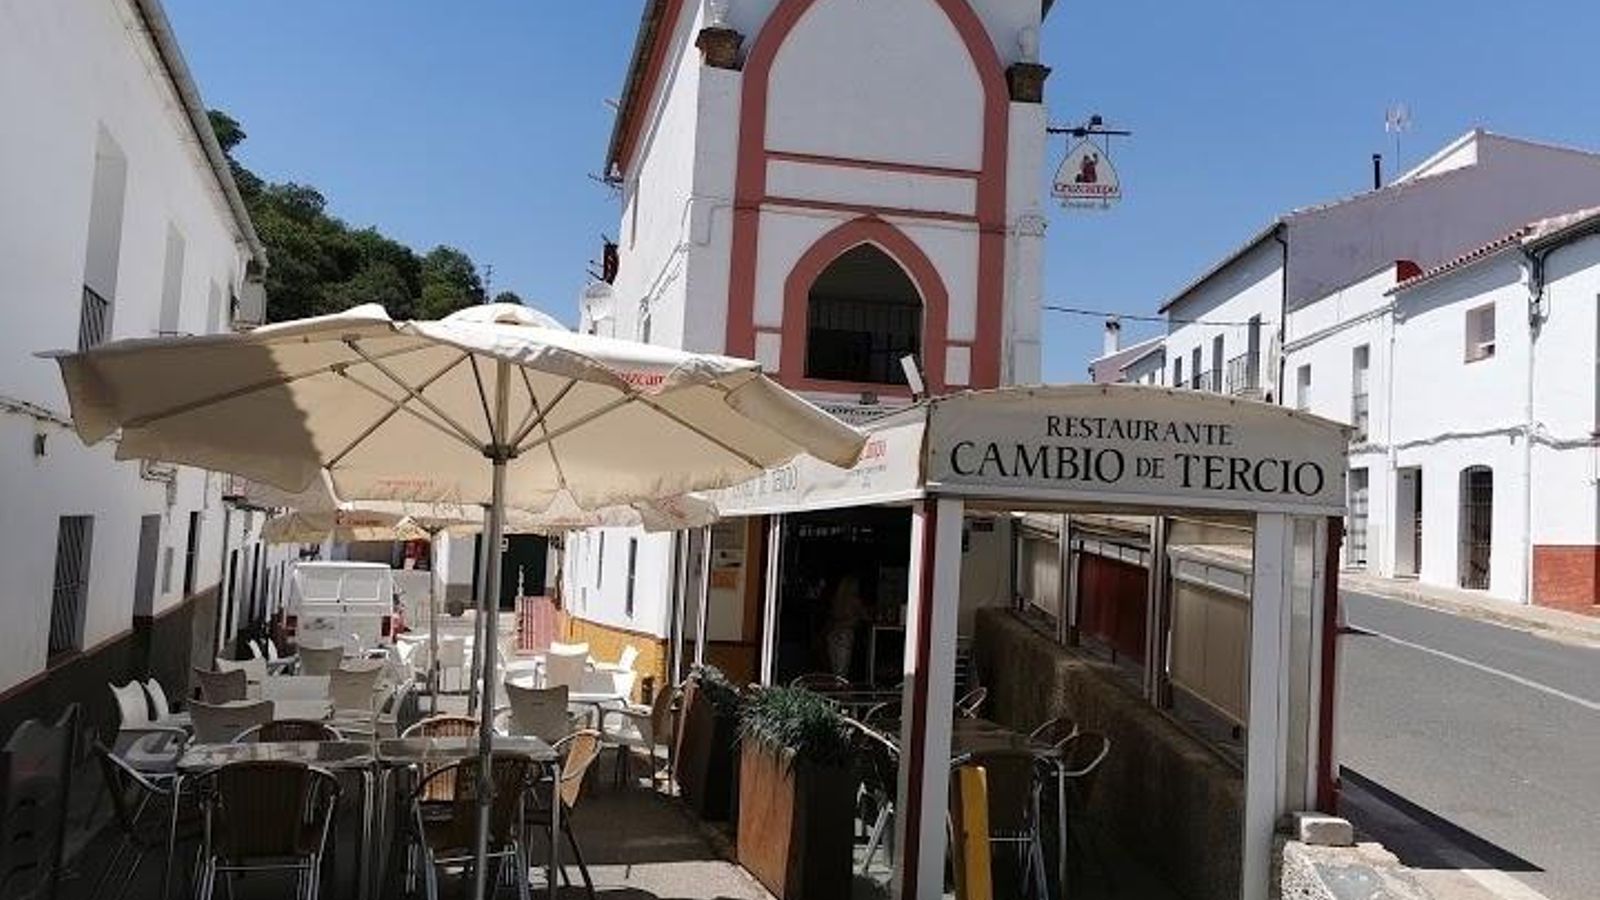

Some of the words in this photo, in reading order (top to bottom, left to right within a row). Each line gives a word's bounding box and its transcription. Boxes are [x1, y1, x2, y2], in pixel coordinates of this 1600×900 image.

[1046, 415, 1232, 446] RESTAURANTE
[950, 441, 1125, 484] CAMBIO
[1136, 457, 1165, 481] DE
[1175, 453, 1325, 497] TERCIO
